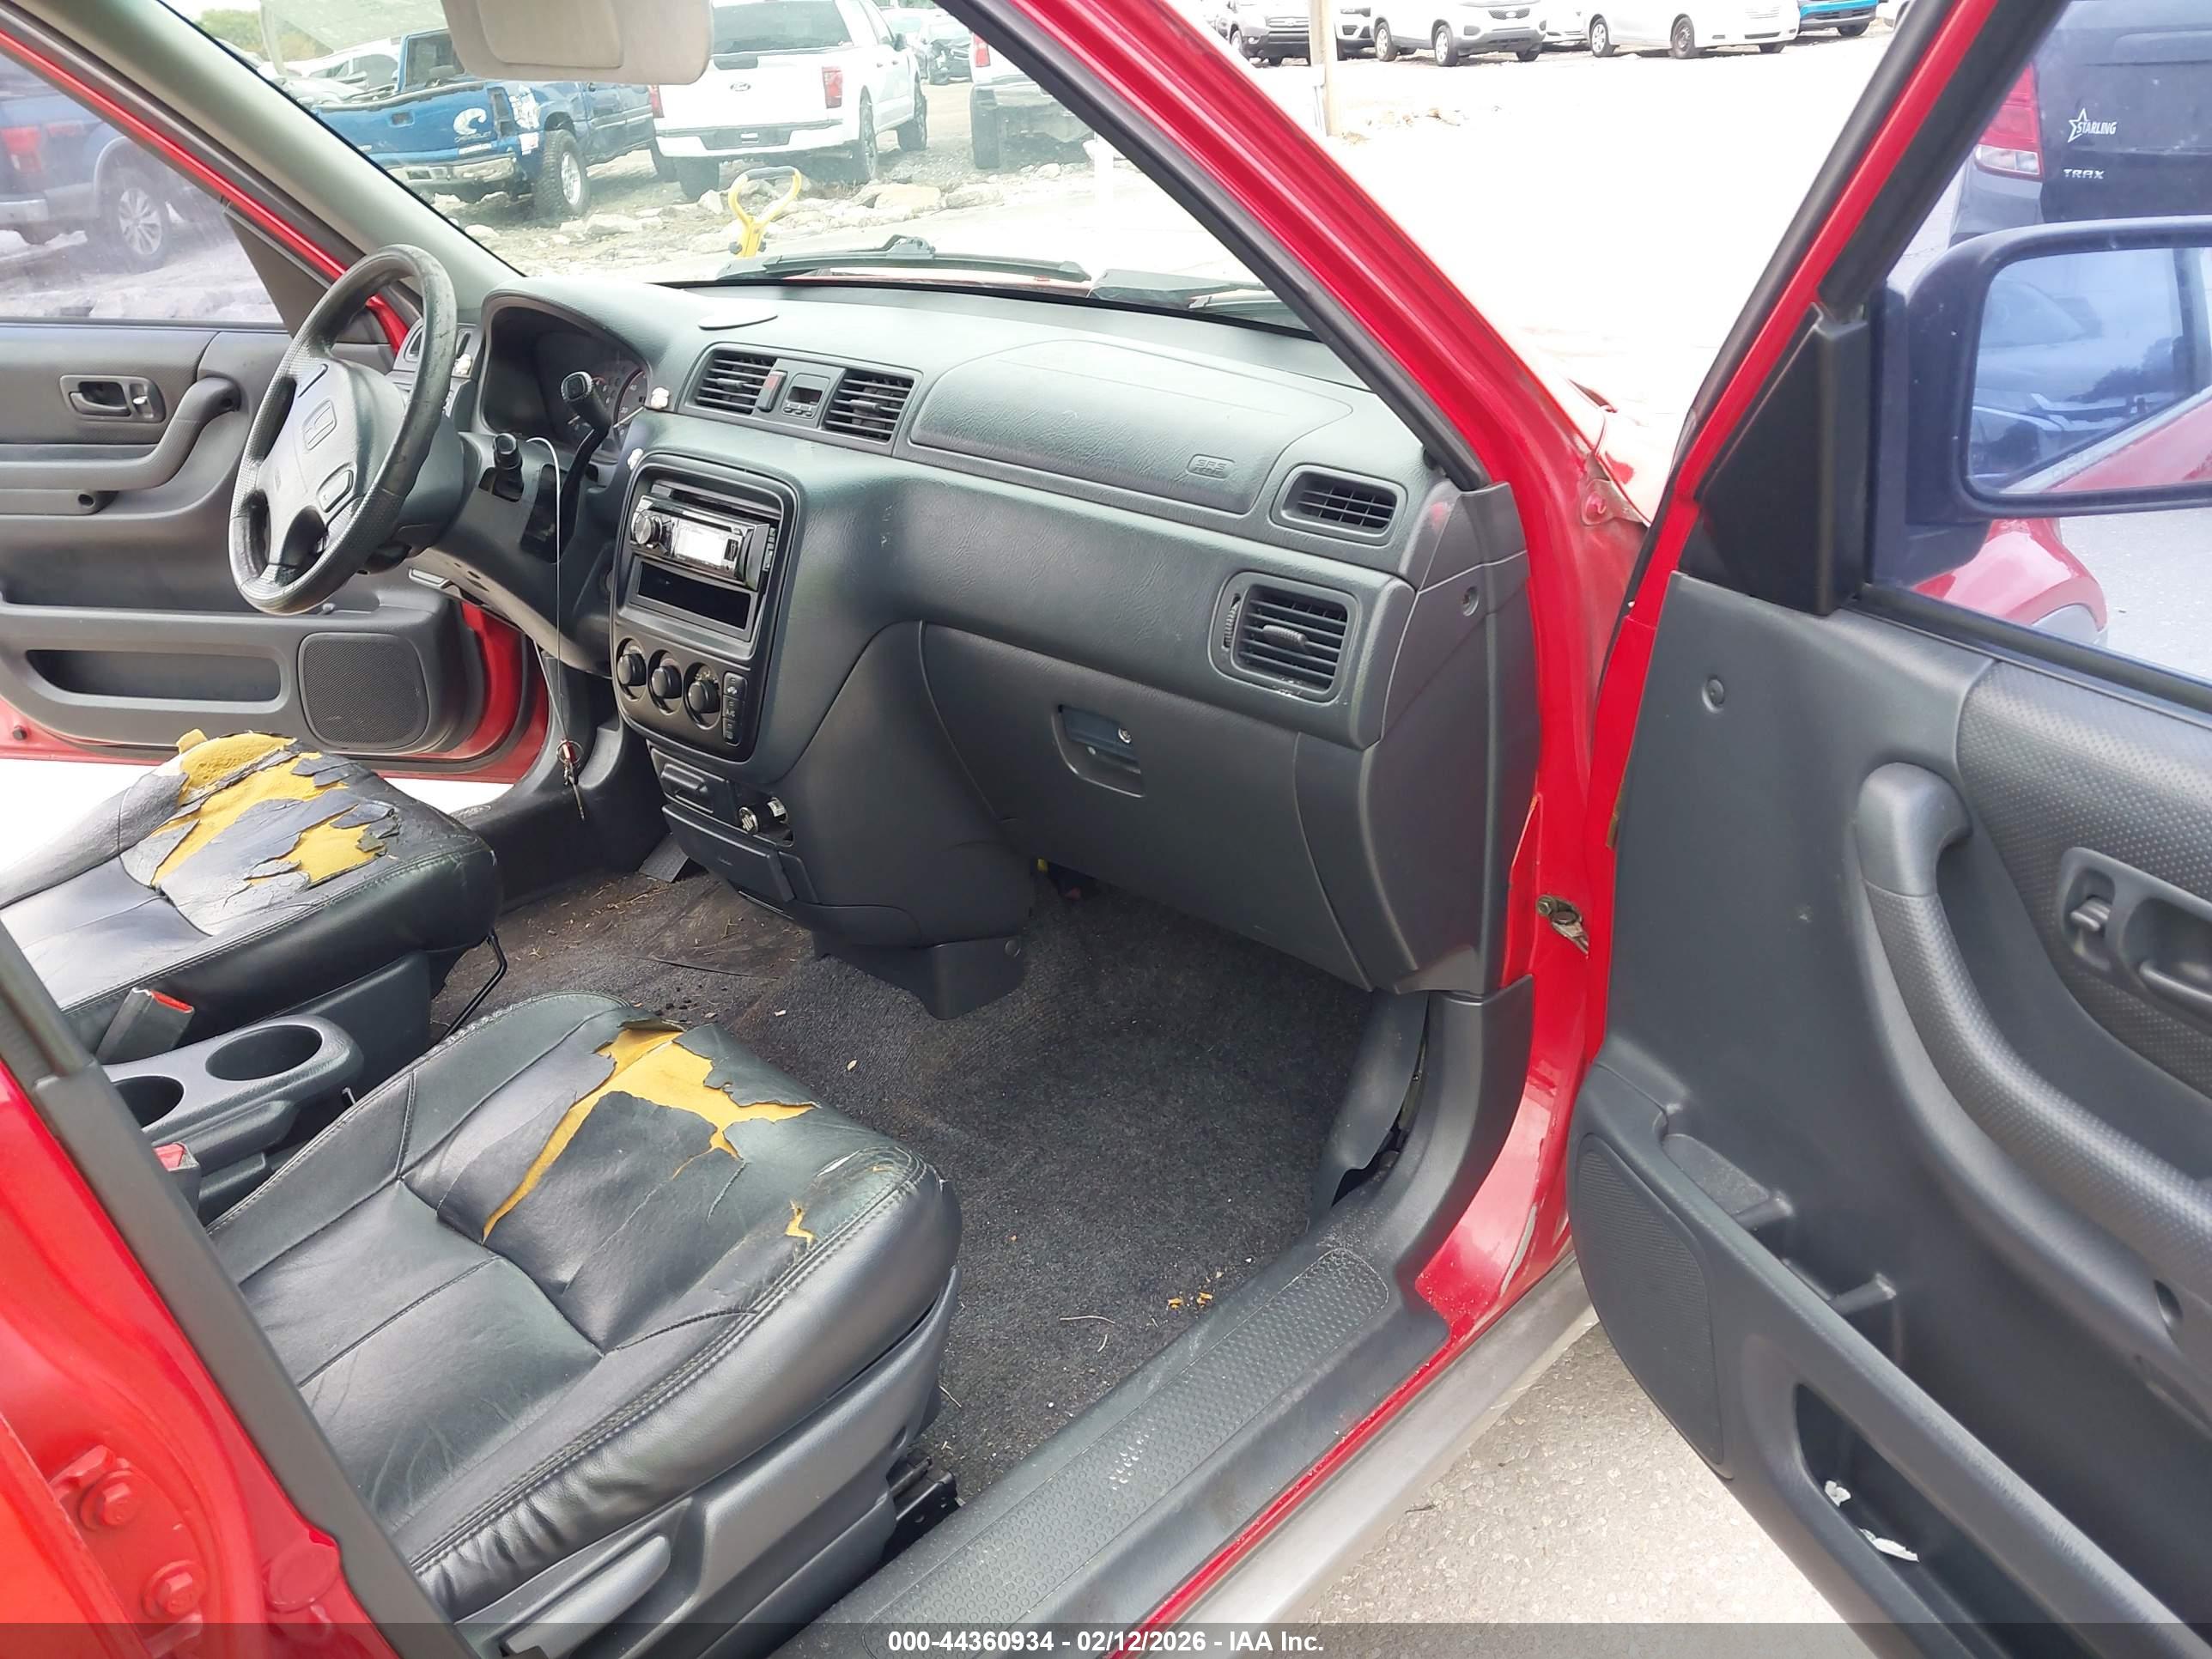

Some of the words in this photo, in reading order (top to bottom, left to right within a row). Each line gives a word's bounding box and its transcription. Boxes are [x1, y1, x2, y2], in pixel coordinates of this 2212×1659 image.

[2075, 120, 2118, 135] STARLING
[2063, 168, 2106, 179] TRAX
[1195, 459, 1227, 471] SRS
